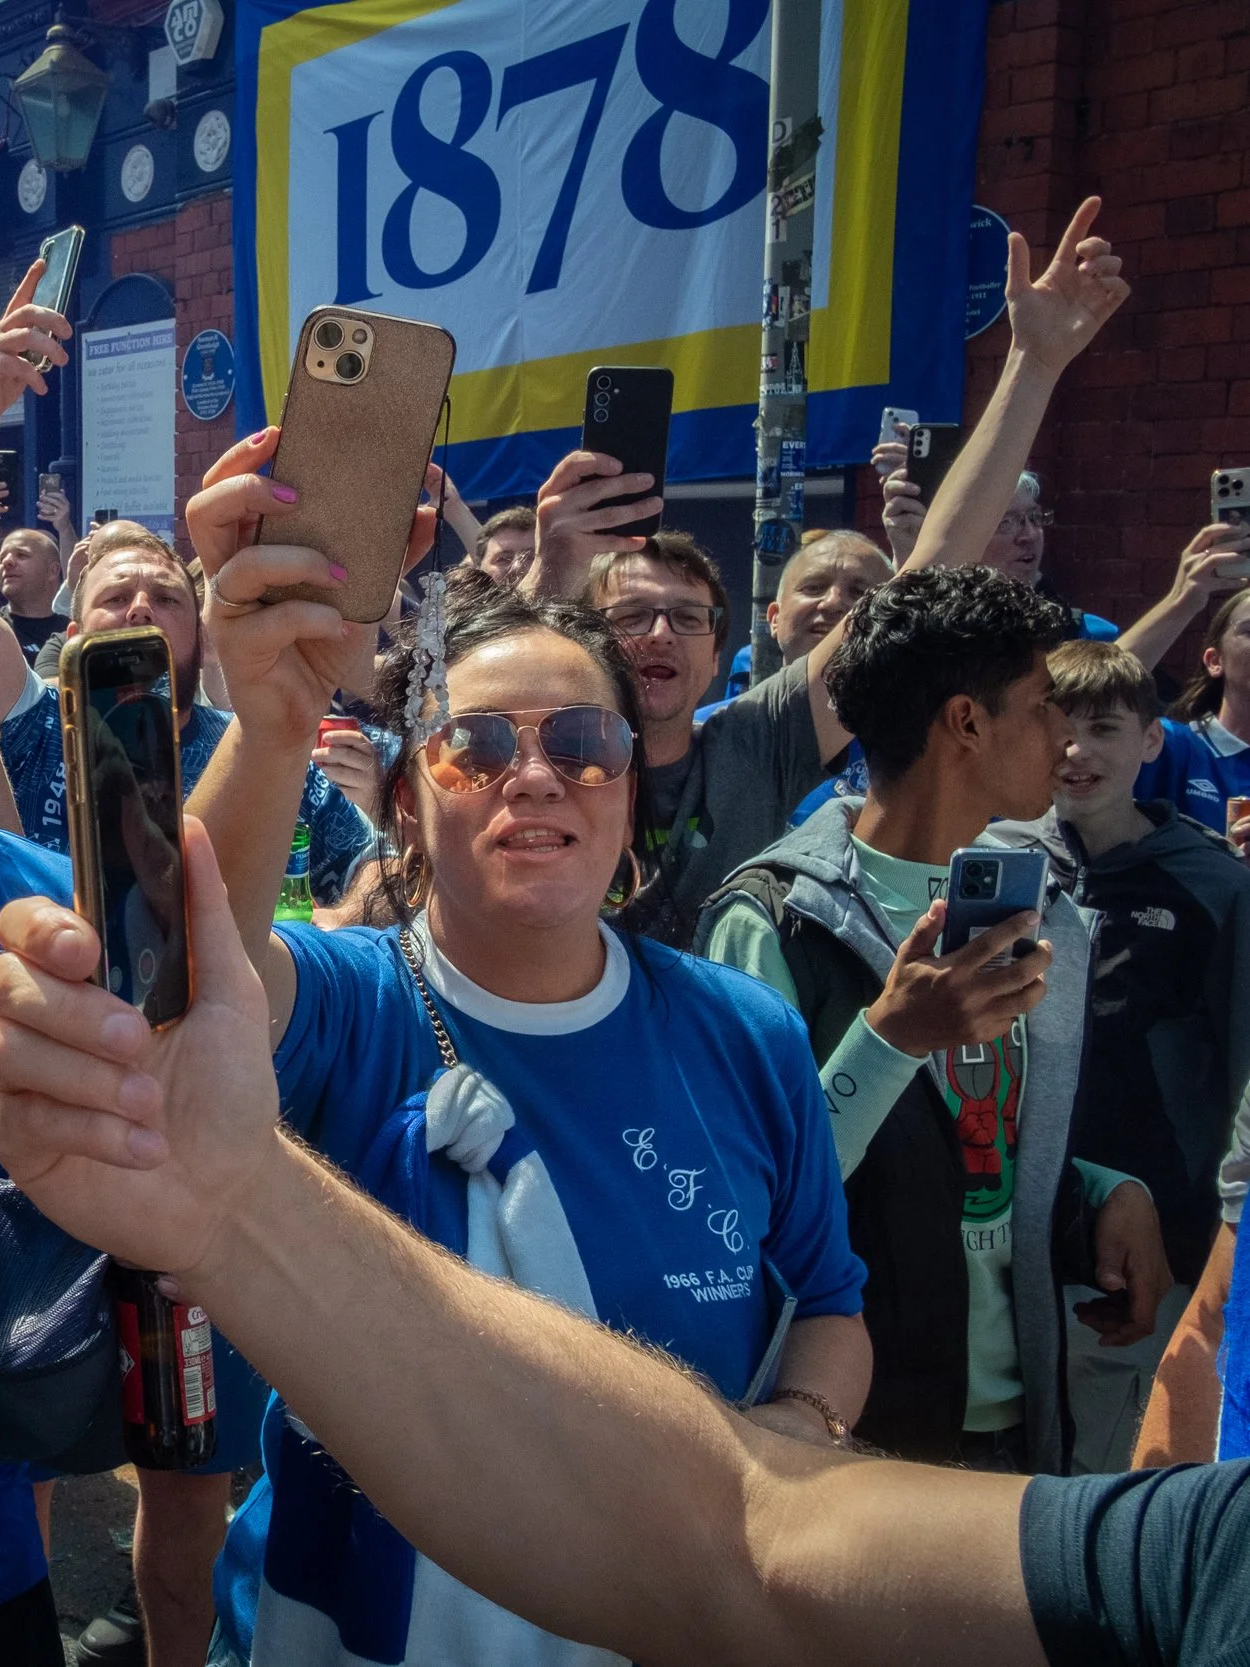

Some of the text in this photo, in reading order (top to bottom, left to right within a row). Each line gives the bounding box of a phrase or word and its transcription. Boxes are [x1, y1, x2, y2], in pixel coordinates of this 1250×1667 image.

[323, 0, 771, 305] 1878
[89, 333, 173, 355] FREE FUNCTION HIRE
[663, 1265, 754, 1288] 1966 F.A. CUP
[691, 1282, 751, 1303] WINNERS
